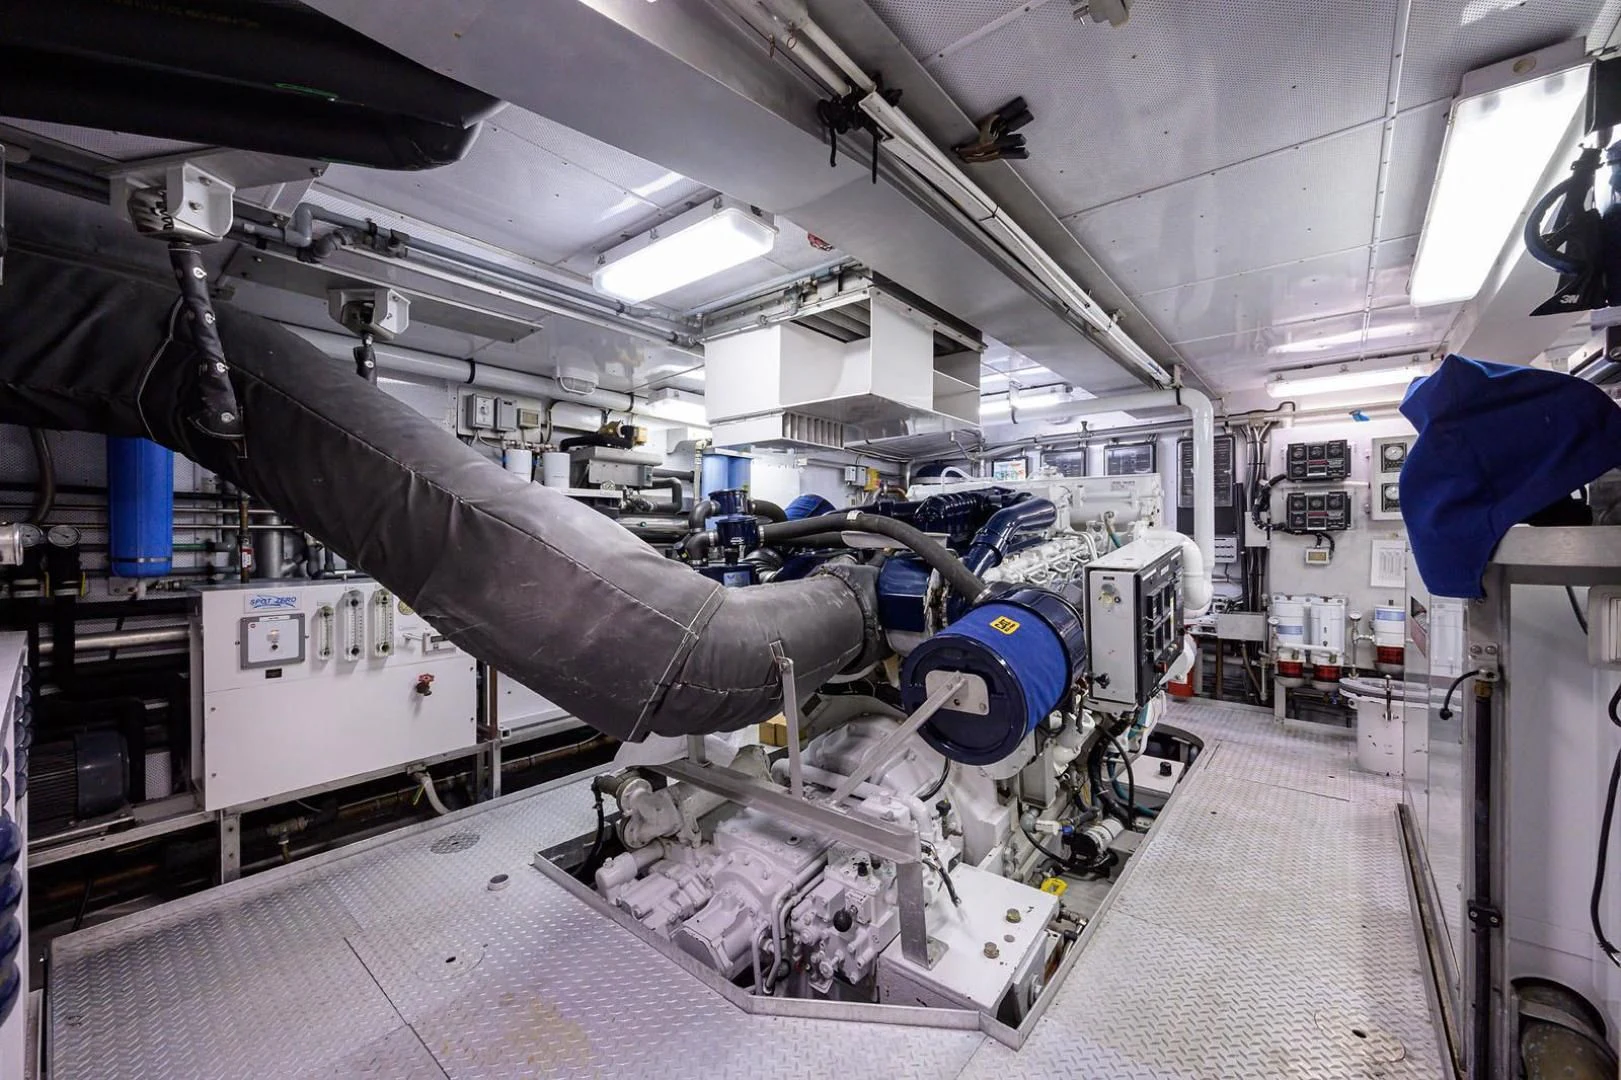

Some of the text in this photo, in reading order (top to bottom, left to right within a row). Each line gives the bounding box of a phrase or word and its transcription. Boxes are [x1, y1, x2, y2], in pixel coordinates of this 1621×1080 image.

[1560, 294, 1580, 304] 3M
[250, 596, 297, 606] SPOT ZERO
